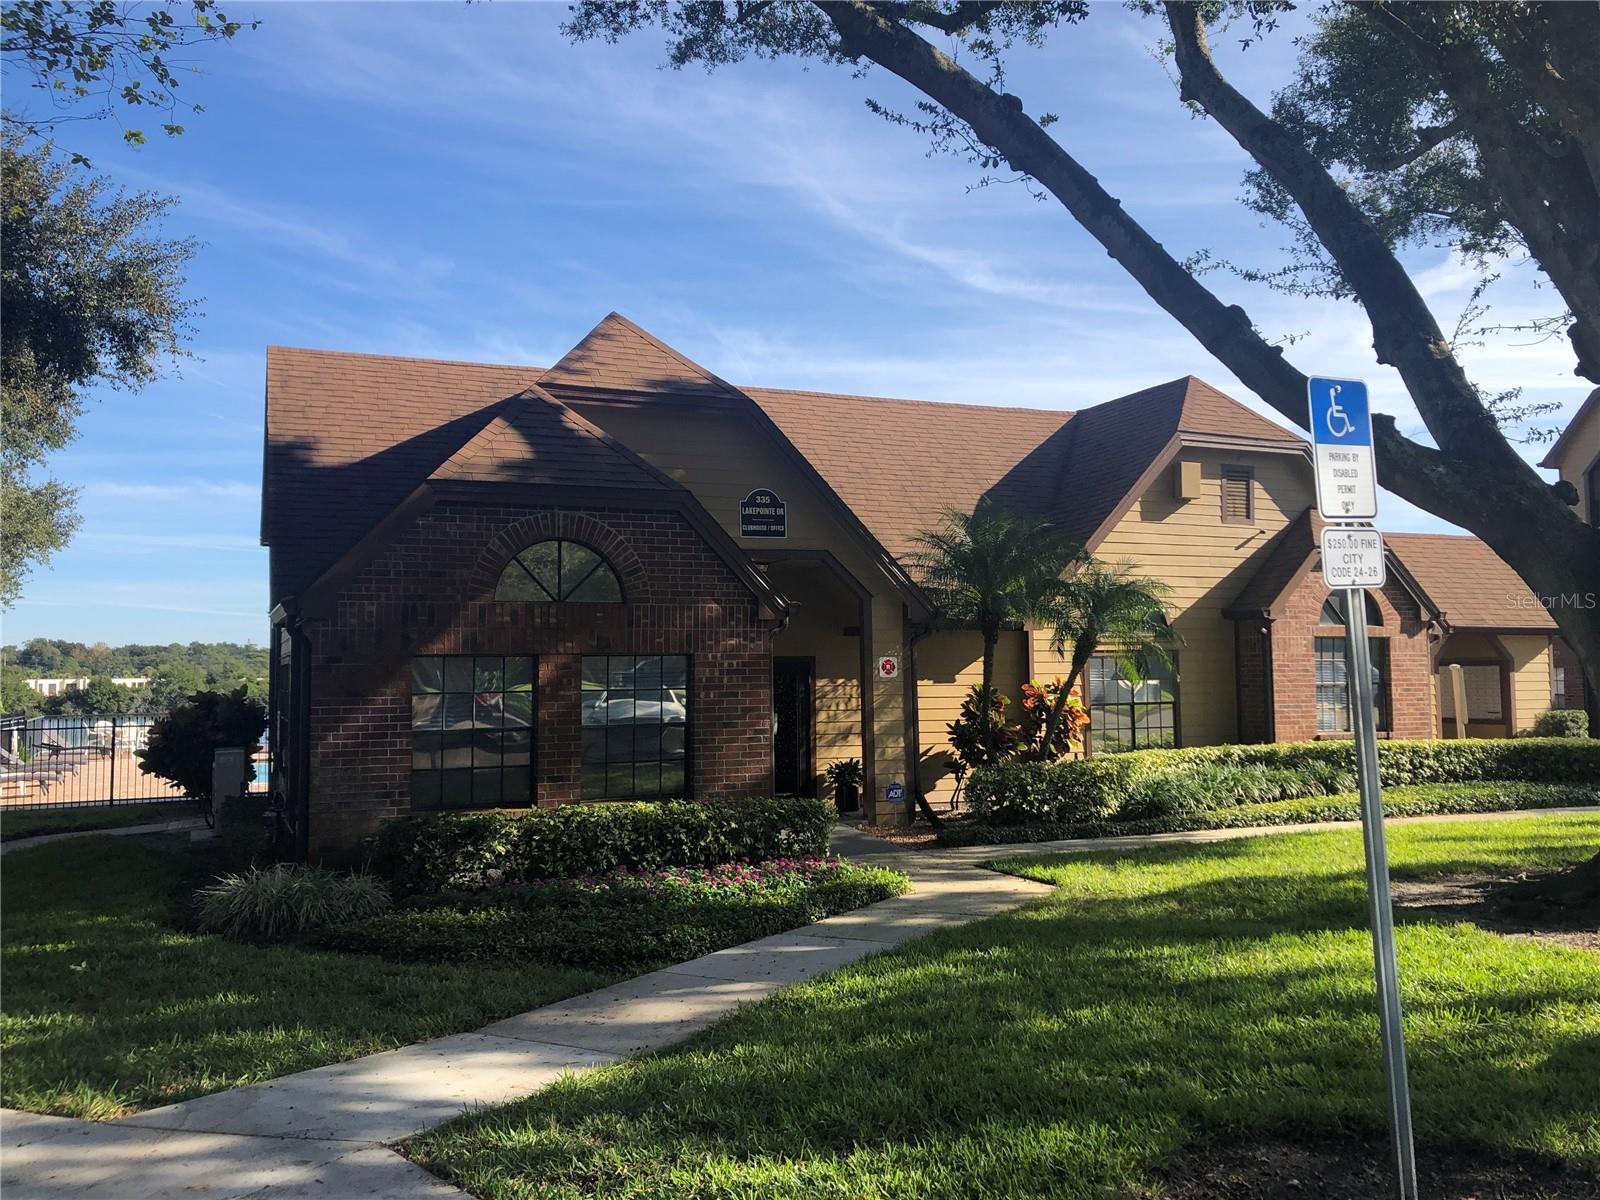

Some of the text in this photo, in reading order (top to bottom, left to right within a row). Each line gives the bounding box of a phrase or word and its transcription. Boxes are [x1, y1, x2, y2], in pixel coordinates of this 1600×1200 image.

[1329, 452, 1359, 462] PARKING BY
[1333, 468, 1358, 478] DISABLED
[1337, 485, 1356, 494] PERMIT
[755, 496, 771, 504] 335
[742, 507, 784, 516] LAKEPOINTE DR
[1328, 538, 1377, 549] $250.00 FINE
[1343, 553, 1363, 564] CITY
[1331, 566, 1378, 578] CODE 24-26
[888, 789, 903, 798] ADT
